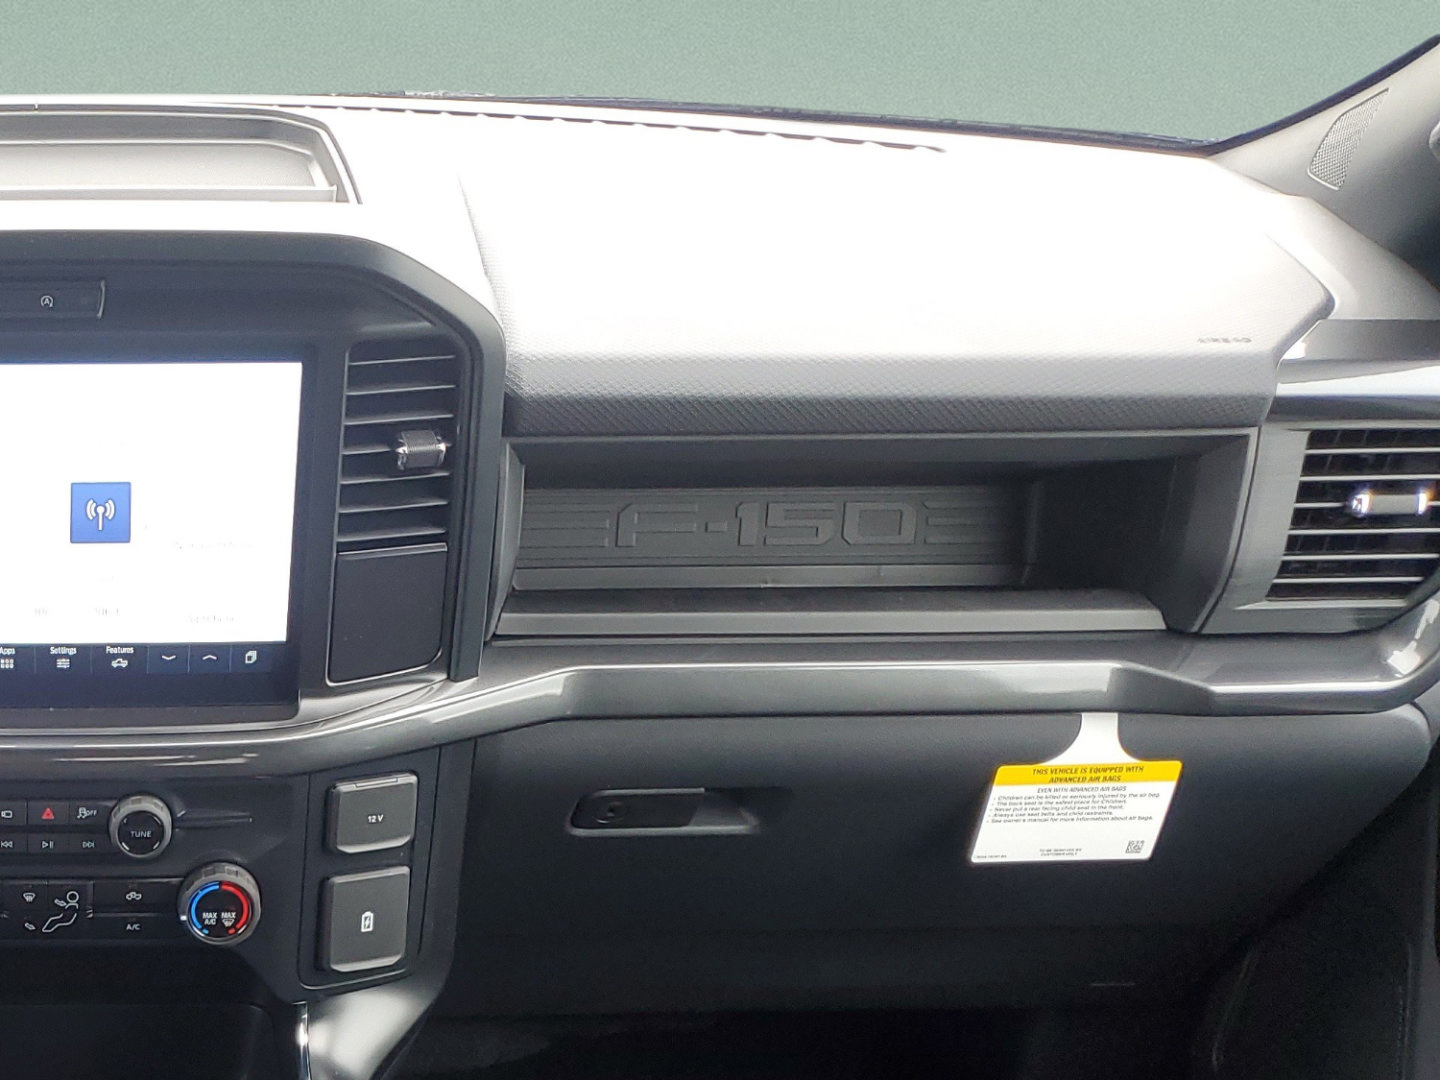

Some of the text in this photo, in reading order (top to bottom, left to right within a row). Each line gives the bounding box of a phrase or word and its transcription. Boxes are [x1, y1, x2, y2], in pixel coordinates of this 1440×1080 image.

[616, 500, 918, 547] F-150
[0, 647, 15, 655] Apps
[50, 646, 77, 655] Settings
[106, 646, 134, 654] Features
[1090, 766, 1124, 774] EQUIPPED
[368, 814, 384, 823] 12 V
[131, 830, 152, 838] TUNE
